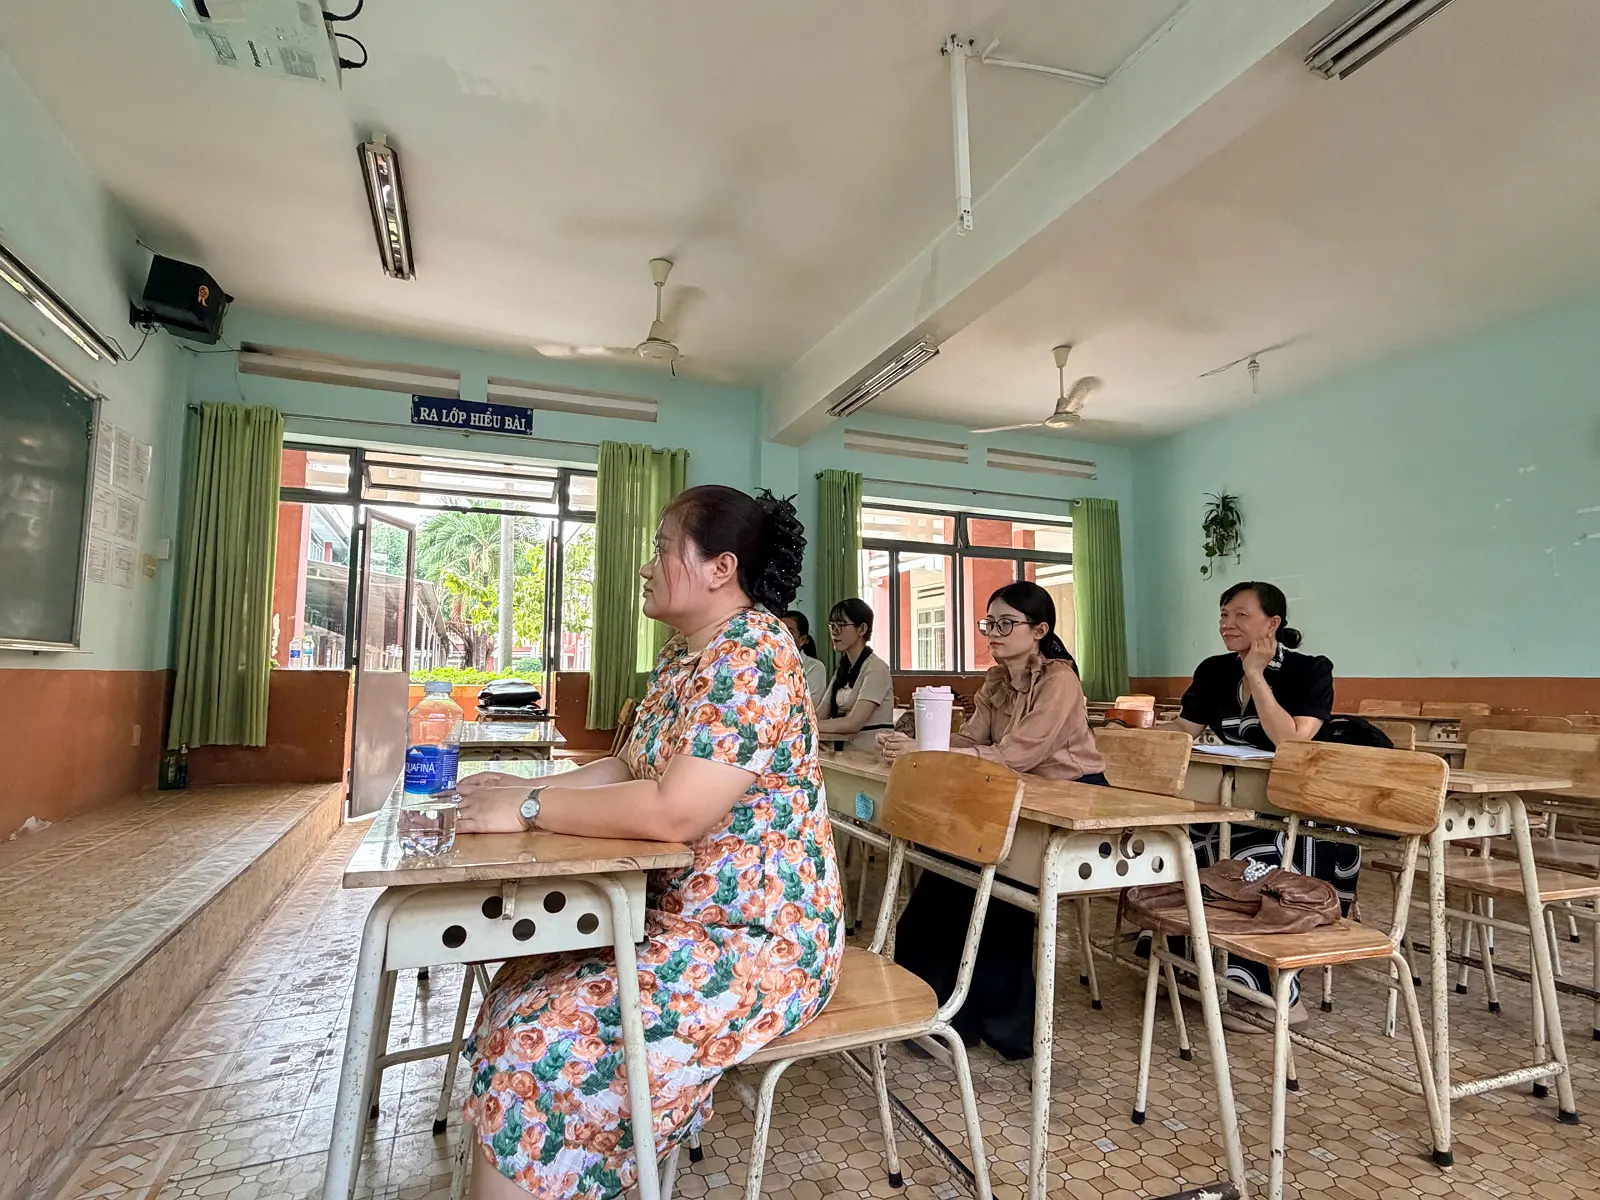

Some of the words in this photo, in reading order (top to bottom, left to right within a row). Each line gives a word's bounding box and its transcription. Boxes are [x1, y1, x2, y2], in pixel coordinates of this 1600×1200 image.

[420, 407, 438, 421] RA
[441, 407, 467, 424] LỚP
[470, 408, 501, 428] HIỂU
[504, 414, 526, 431] BÀI
[406, 762, 436, 774] QUAFINA
